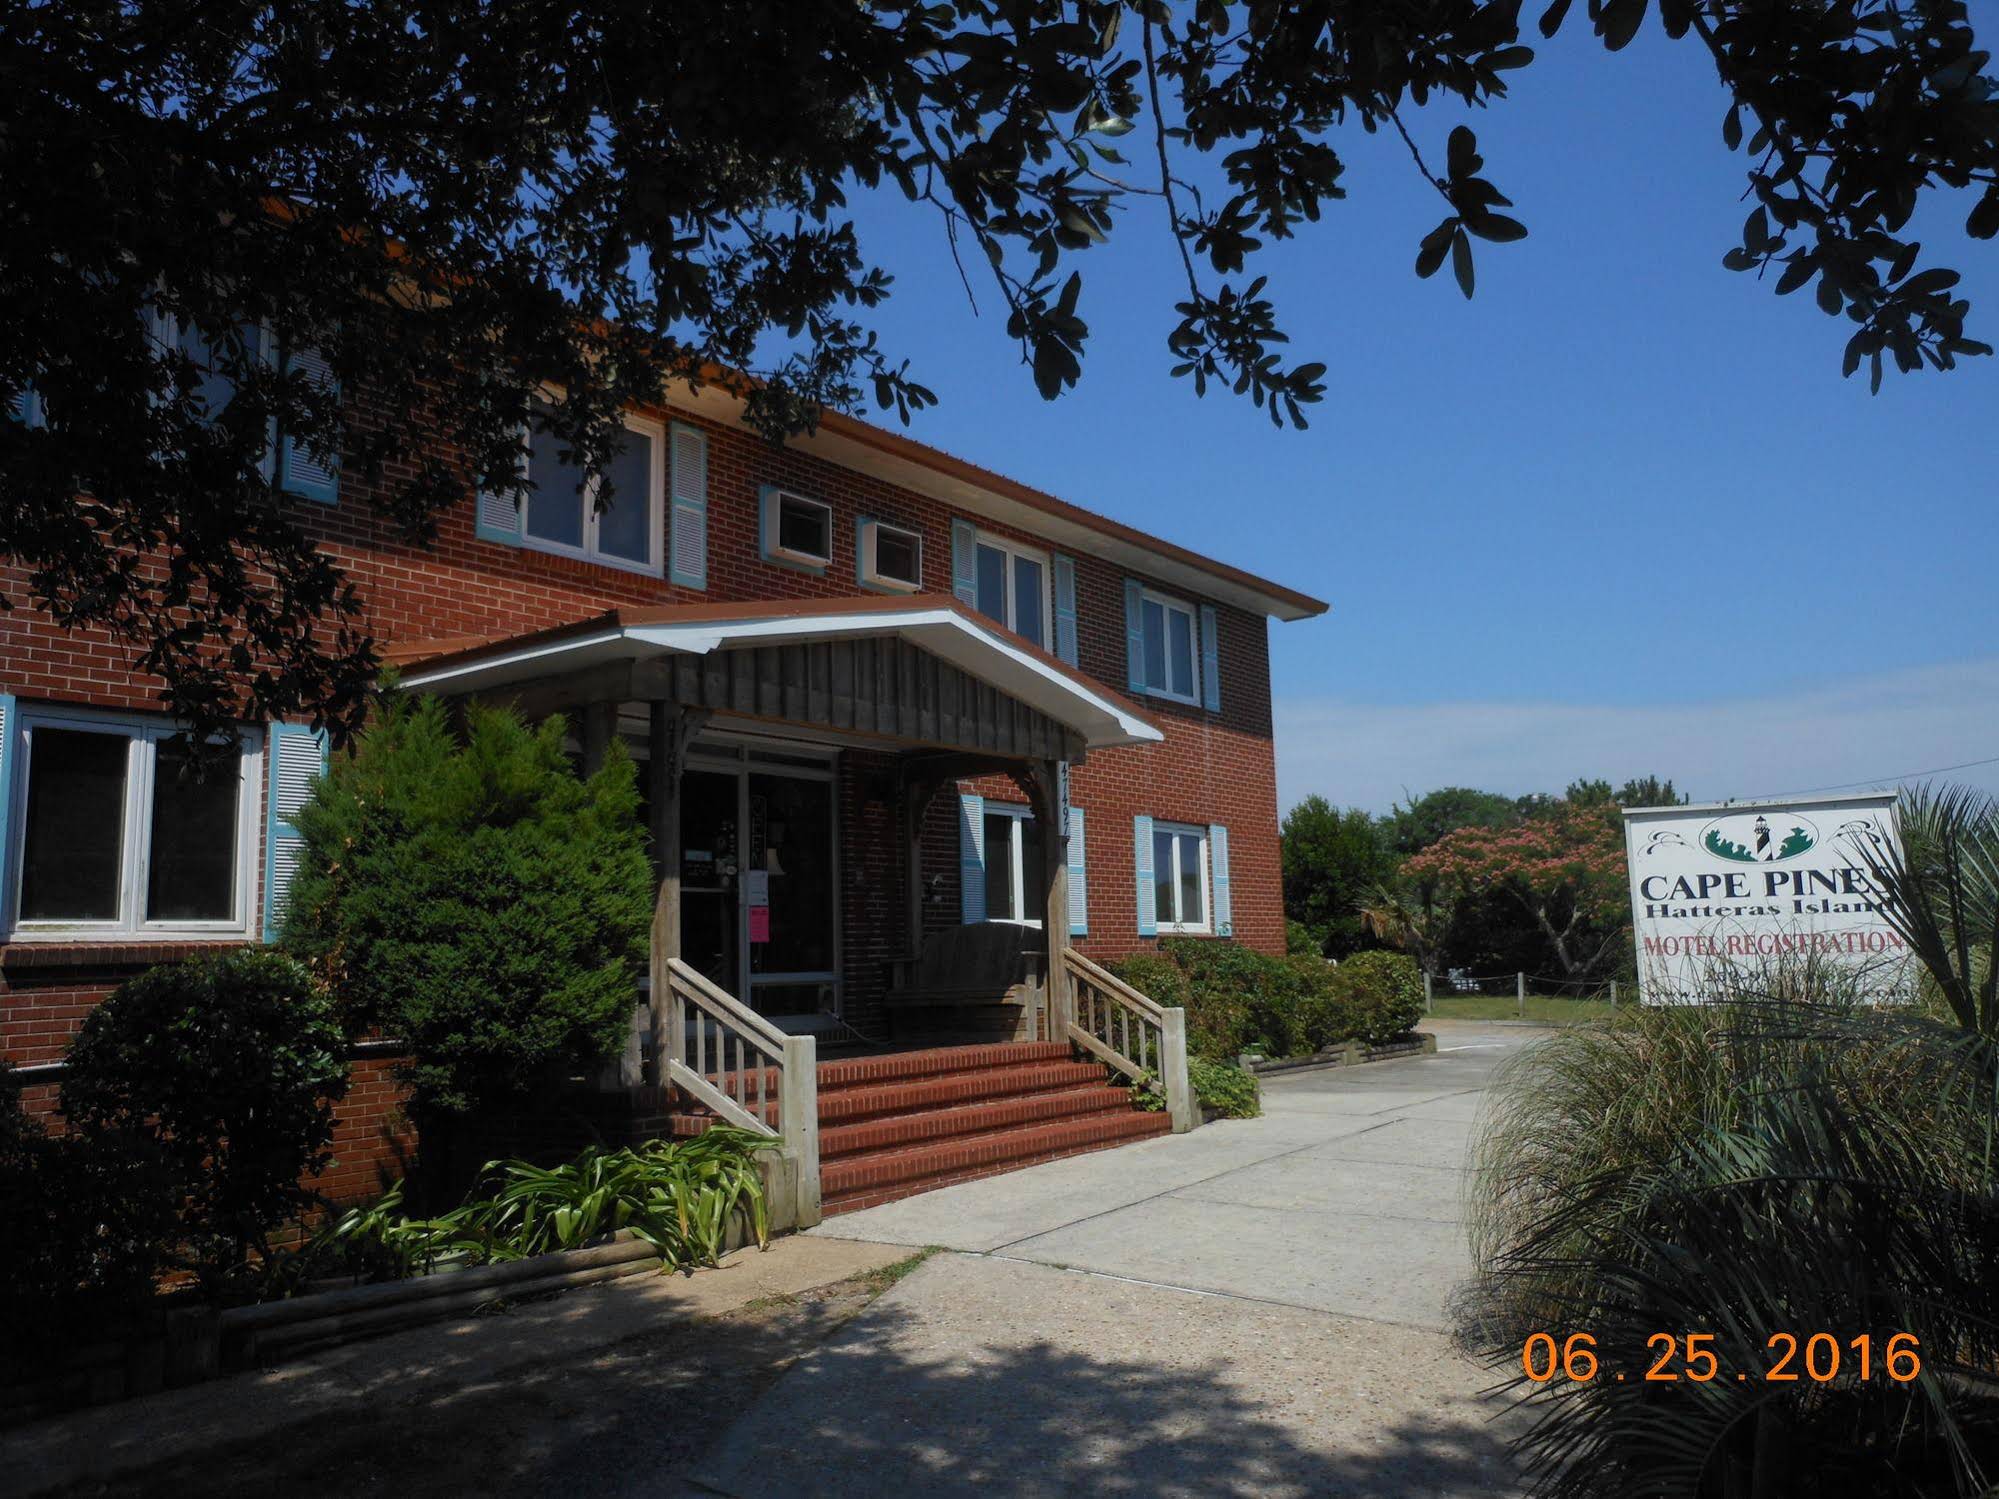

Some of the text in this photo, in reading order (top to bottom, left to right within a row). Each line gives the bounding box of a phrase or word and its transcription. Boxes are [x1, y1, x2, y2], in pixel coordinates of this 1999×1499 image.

[1640, 872, 1751, 901] CAPE
[1646, 903, 1781, 918] Hatteras
[1643, 931, 1905, 956] MOTEL REGISTRATION
